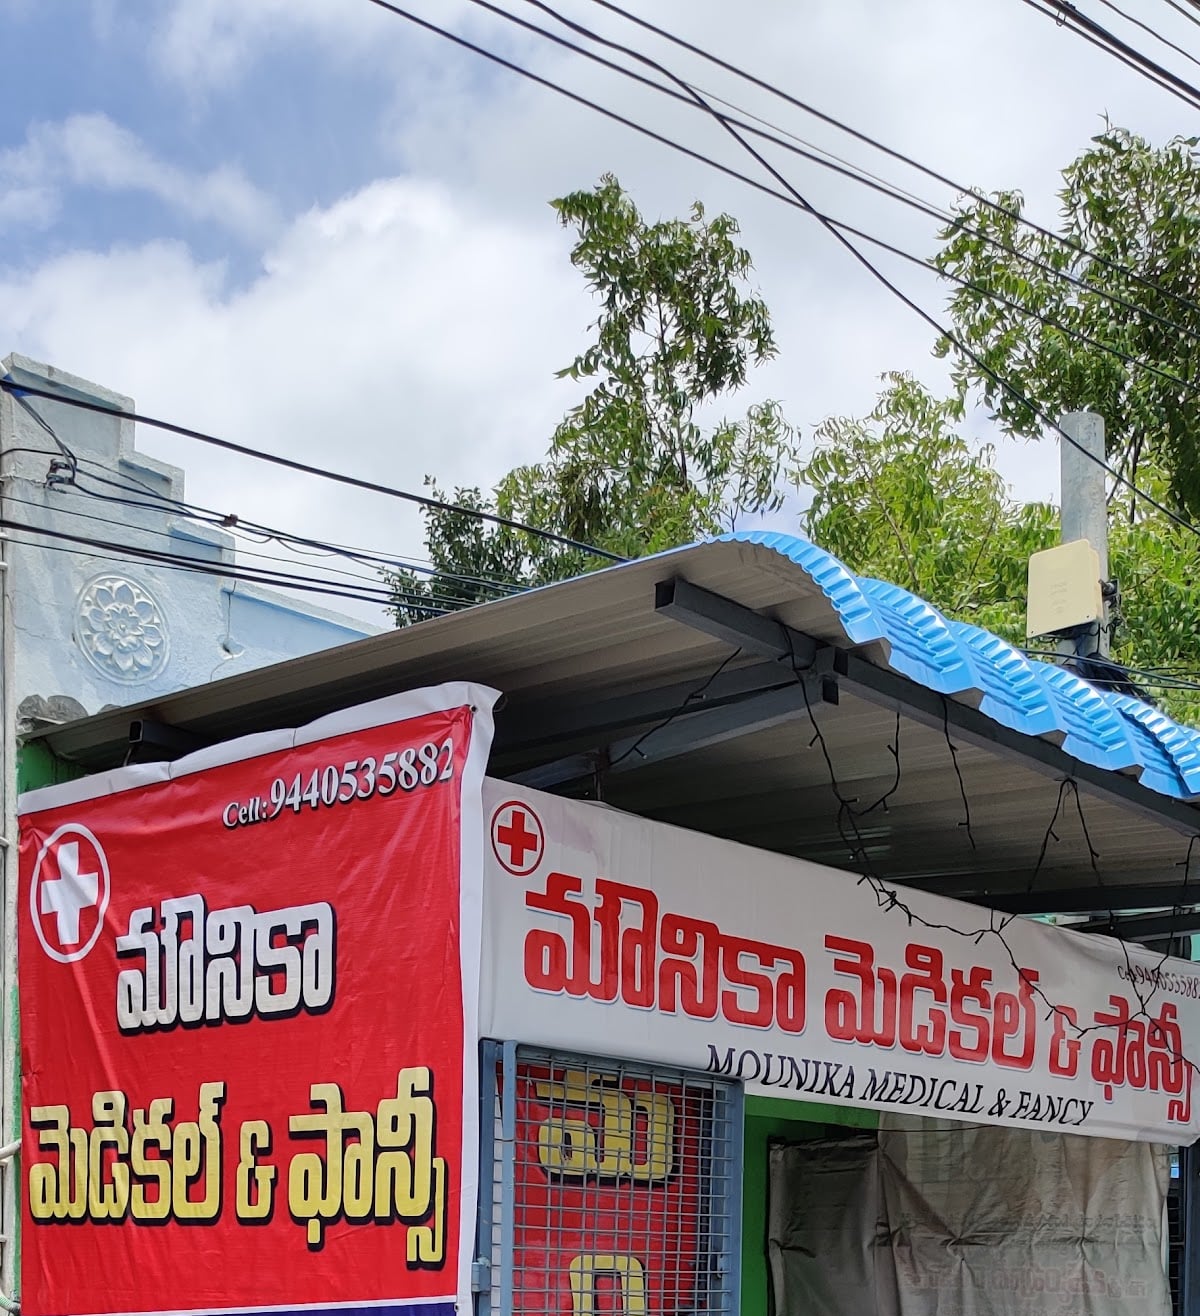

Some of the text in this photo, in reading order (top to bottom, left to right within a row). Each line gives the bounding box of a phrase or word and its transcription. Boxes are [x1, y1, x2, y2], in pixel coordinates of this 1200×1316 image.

[116, 893, 335, 1032] మౌనికా
[525, 873, 805, 1034] మౌనికా
[824, 934, 1038, 1070] మెడికల్
[1048, 1016, 1083, 1078] &
[29, 1080, 225, 1222] మెడికల్
[236, 1119, 275, 1220] &
[706, 1044, 1095, 1127] MOUNIKA MEDICAL & FANCY
